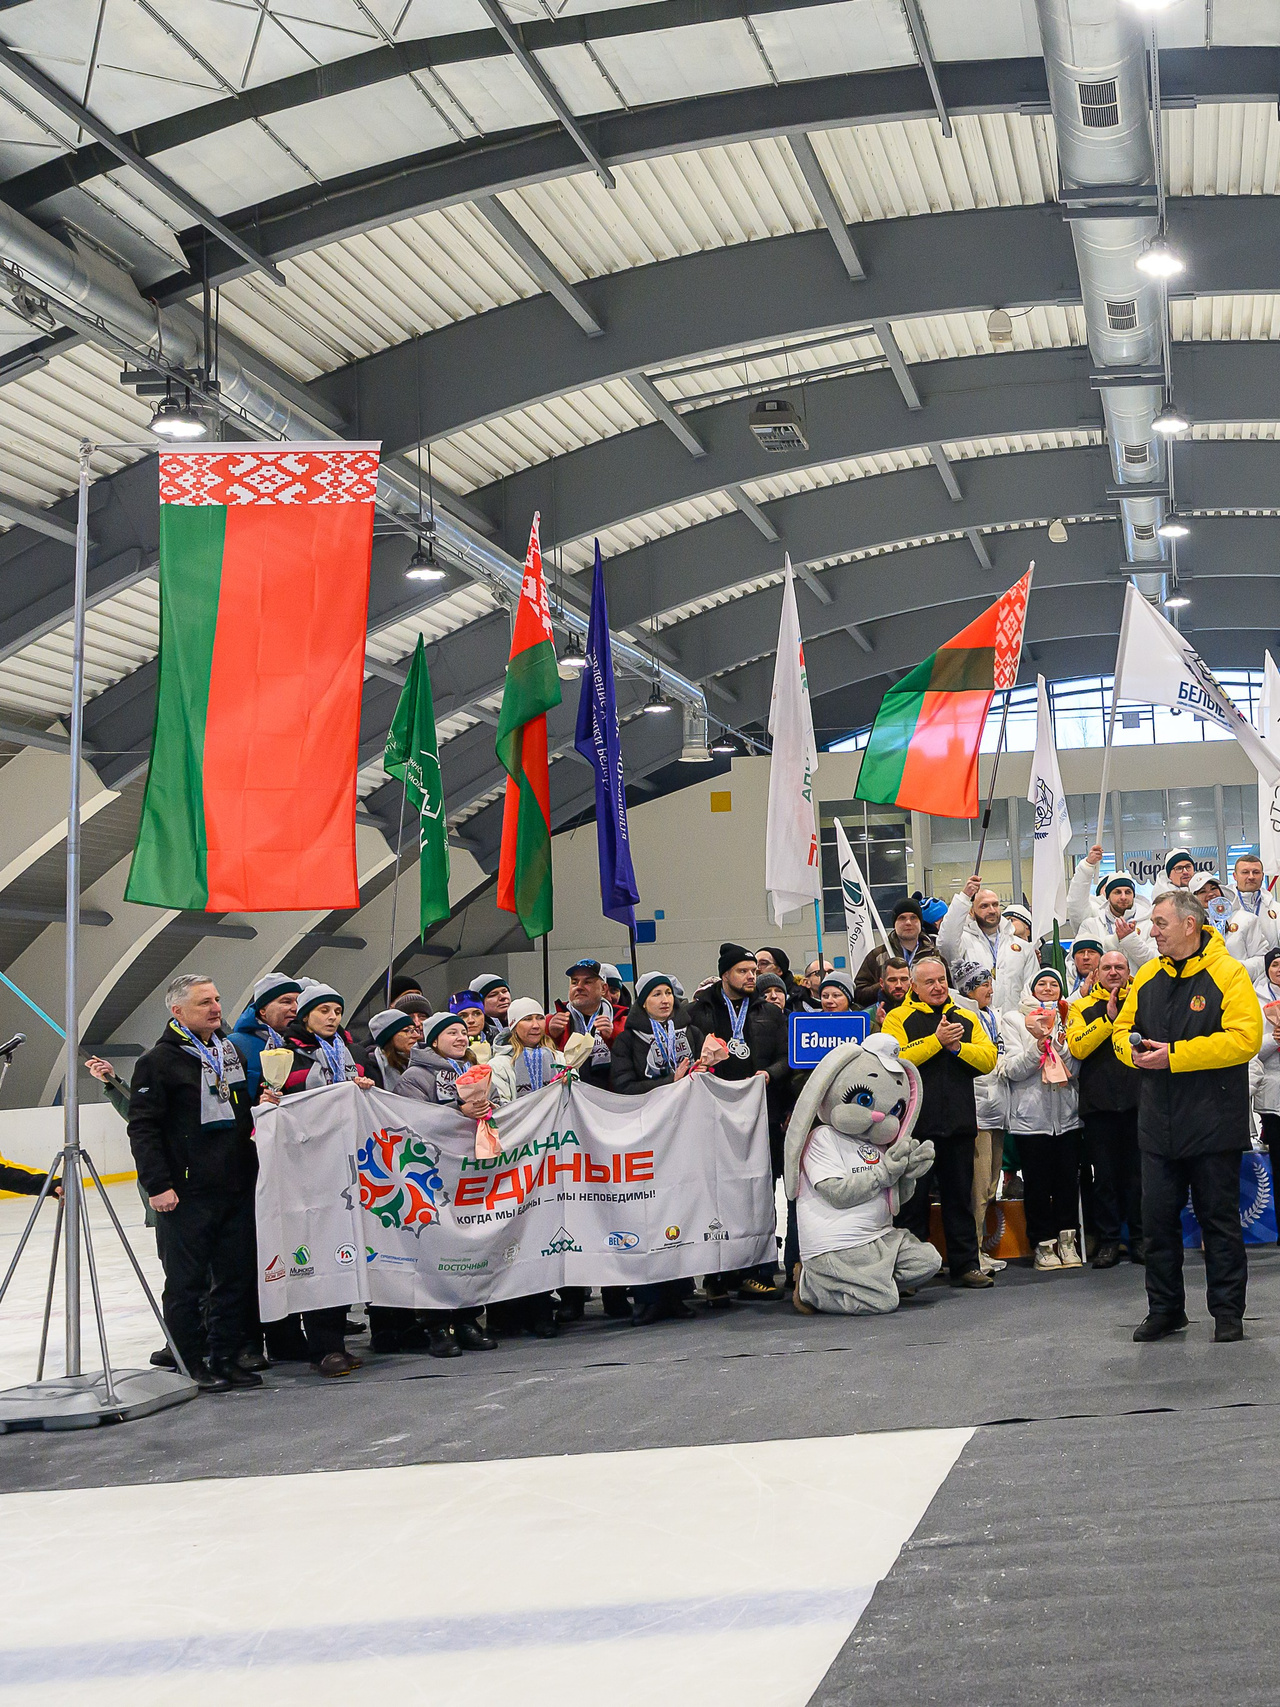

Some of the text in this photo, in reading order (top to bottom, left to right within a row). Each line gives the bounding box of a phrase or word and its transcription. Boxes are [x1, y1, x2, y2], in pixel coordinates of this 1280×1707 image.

[461, 1130, 580, 1172] КОМАНДА
[454, 1150, 654, 1210] ЕДИНЫЕ
[456, 1213, 492, 1225] КОГДА
[495, 1208, 516, 1221] МЫ
[556, 1191, 576, 1202] МЫ
[579, 1189, 657, 1204] НЕПОБЕДИМЫ!
[438, 1259, 489, 1272] ВОСТОЧНЫЙ
